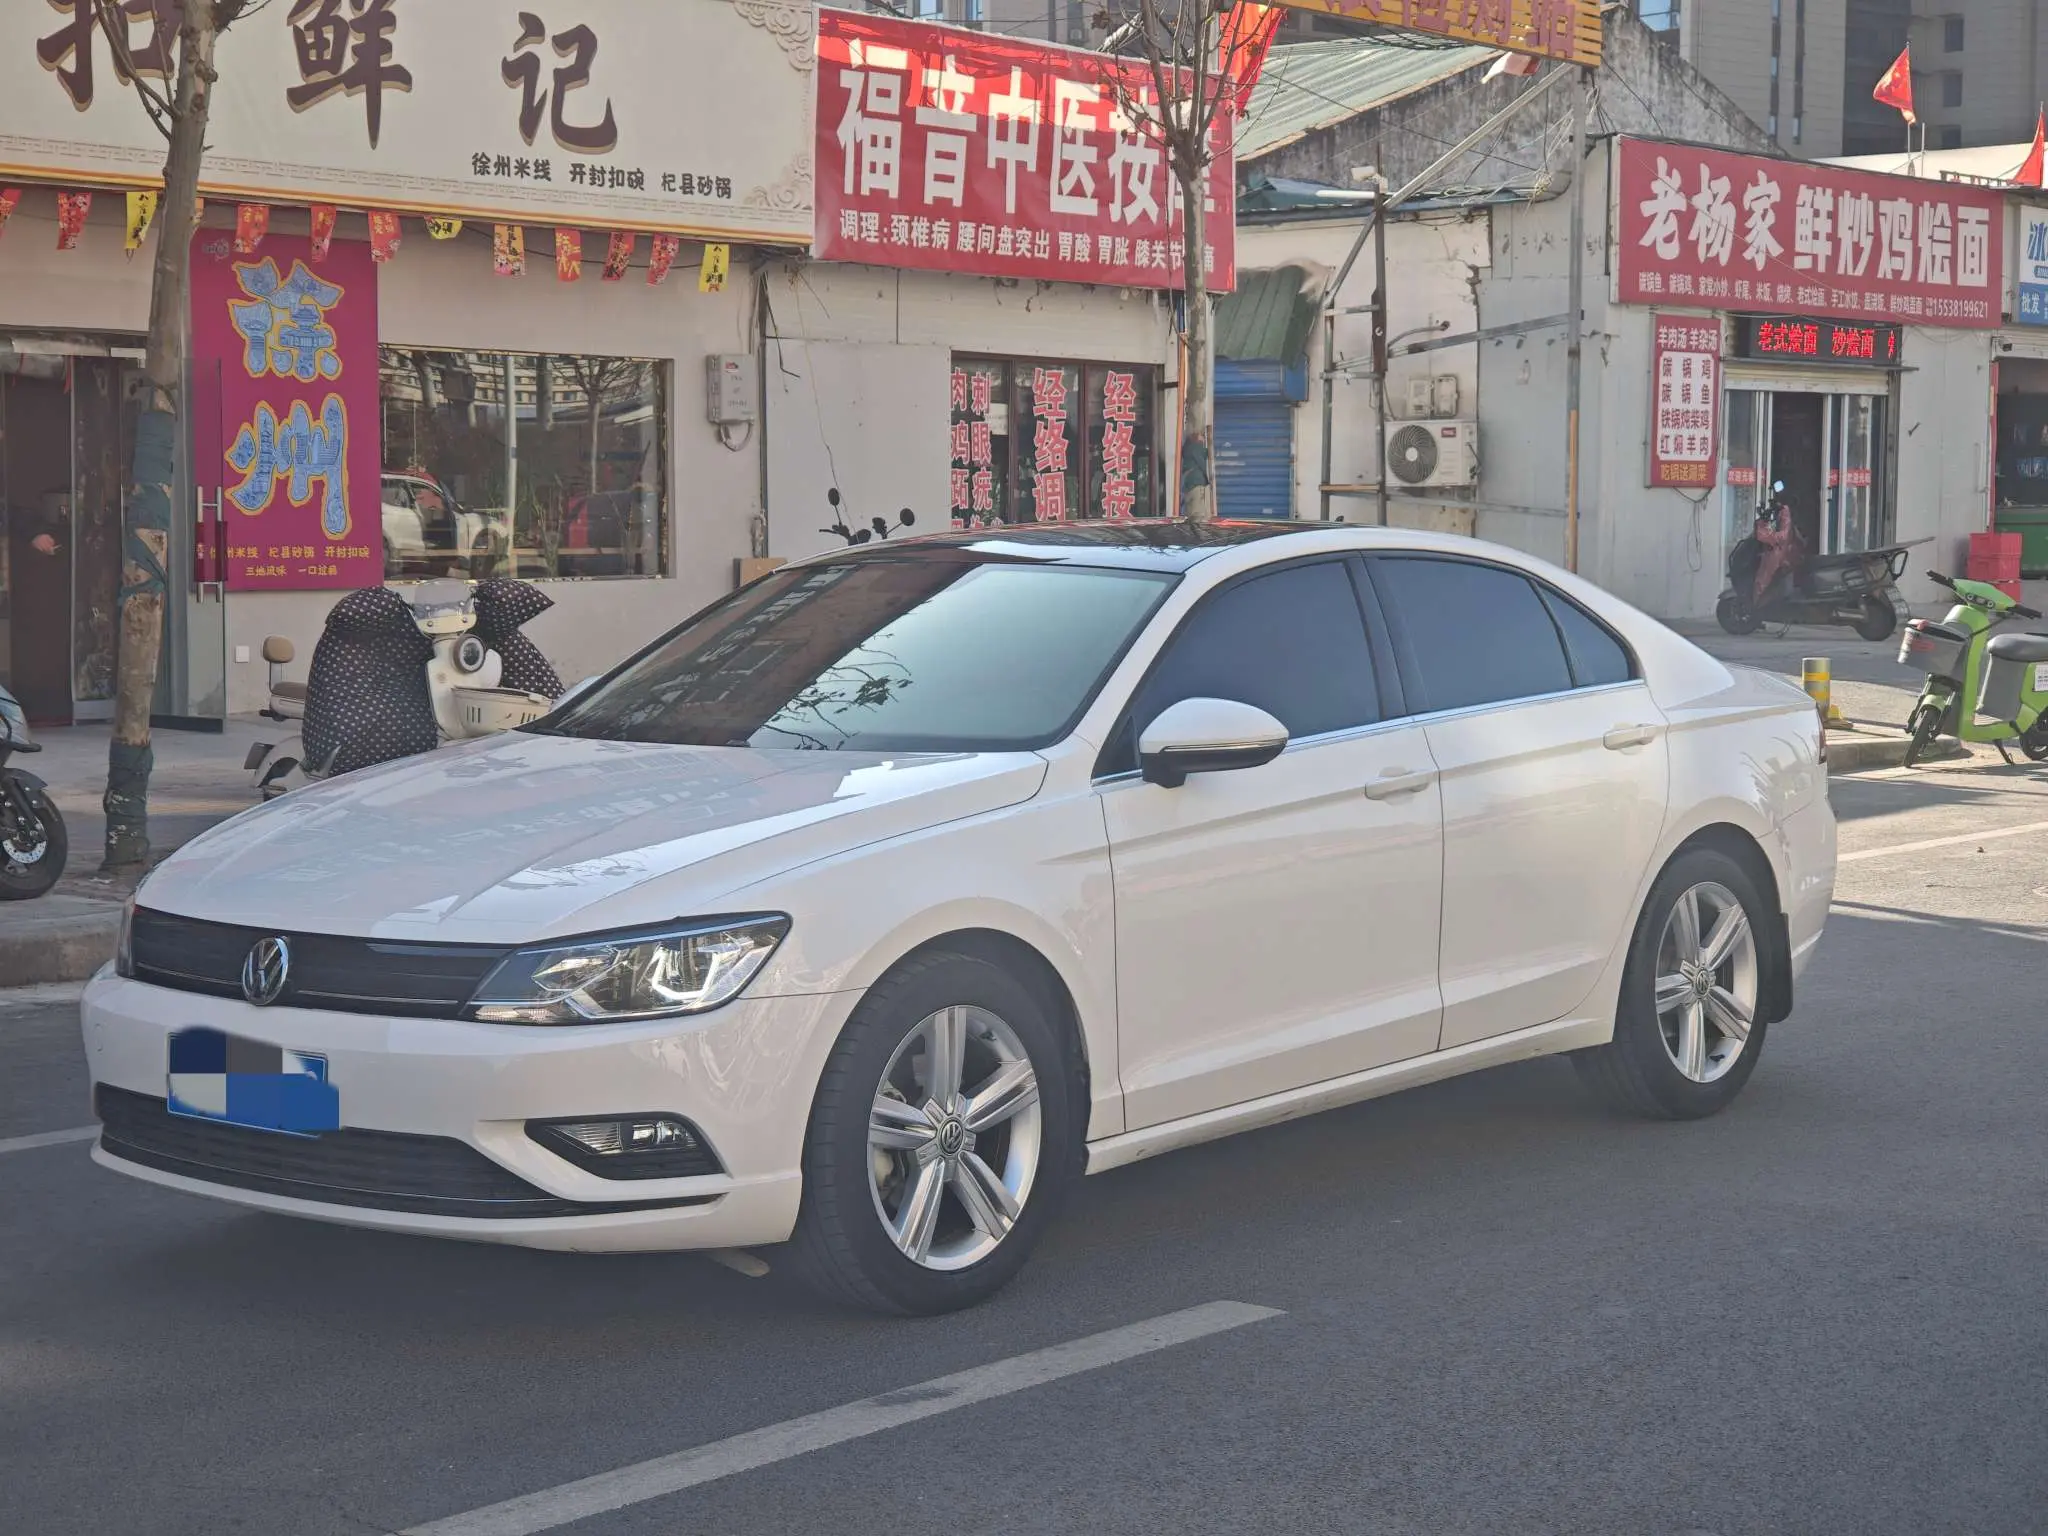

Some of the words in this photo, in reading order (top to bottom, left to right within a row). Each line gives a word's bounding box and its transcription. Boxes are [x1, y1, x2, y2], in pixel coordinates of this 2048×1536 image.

[471, 151, 552, 182] 徐州米线
[569, 162, 645, 191] 开封扣碗
[661, 172, 732, 199] 杞县砂锅
[1638, 156, 1784, 272] 老杨家
[1793, 183, 1990, 288] 鲜炒鸡烩面
[956, 222, 1050, 261] 腰间盘突出
[1058, 231, 1092, 263] 胃酸
[1098, 235, 1130, 266] 胃胀
[1135, 239, 1215, 273] 膝关节痛
[1758, 320, 1819, 356] 老式烩面
